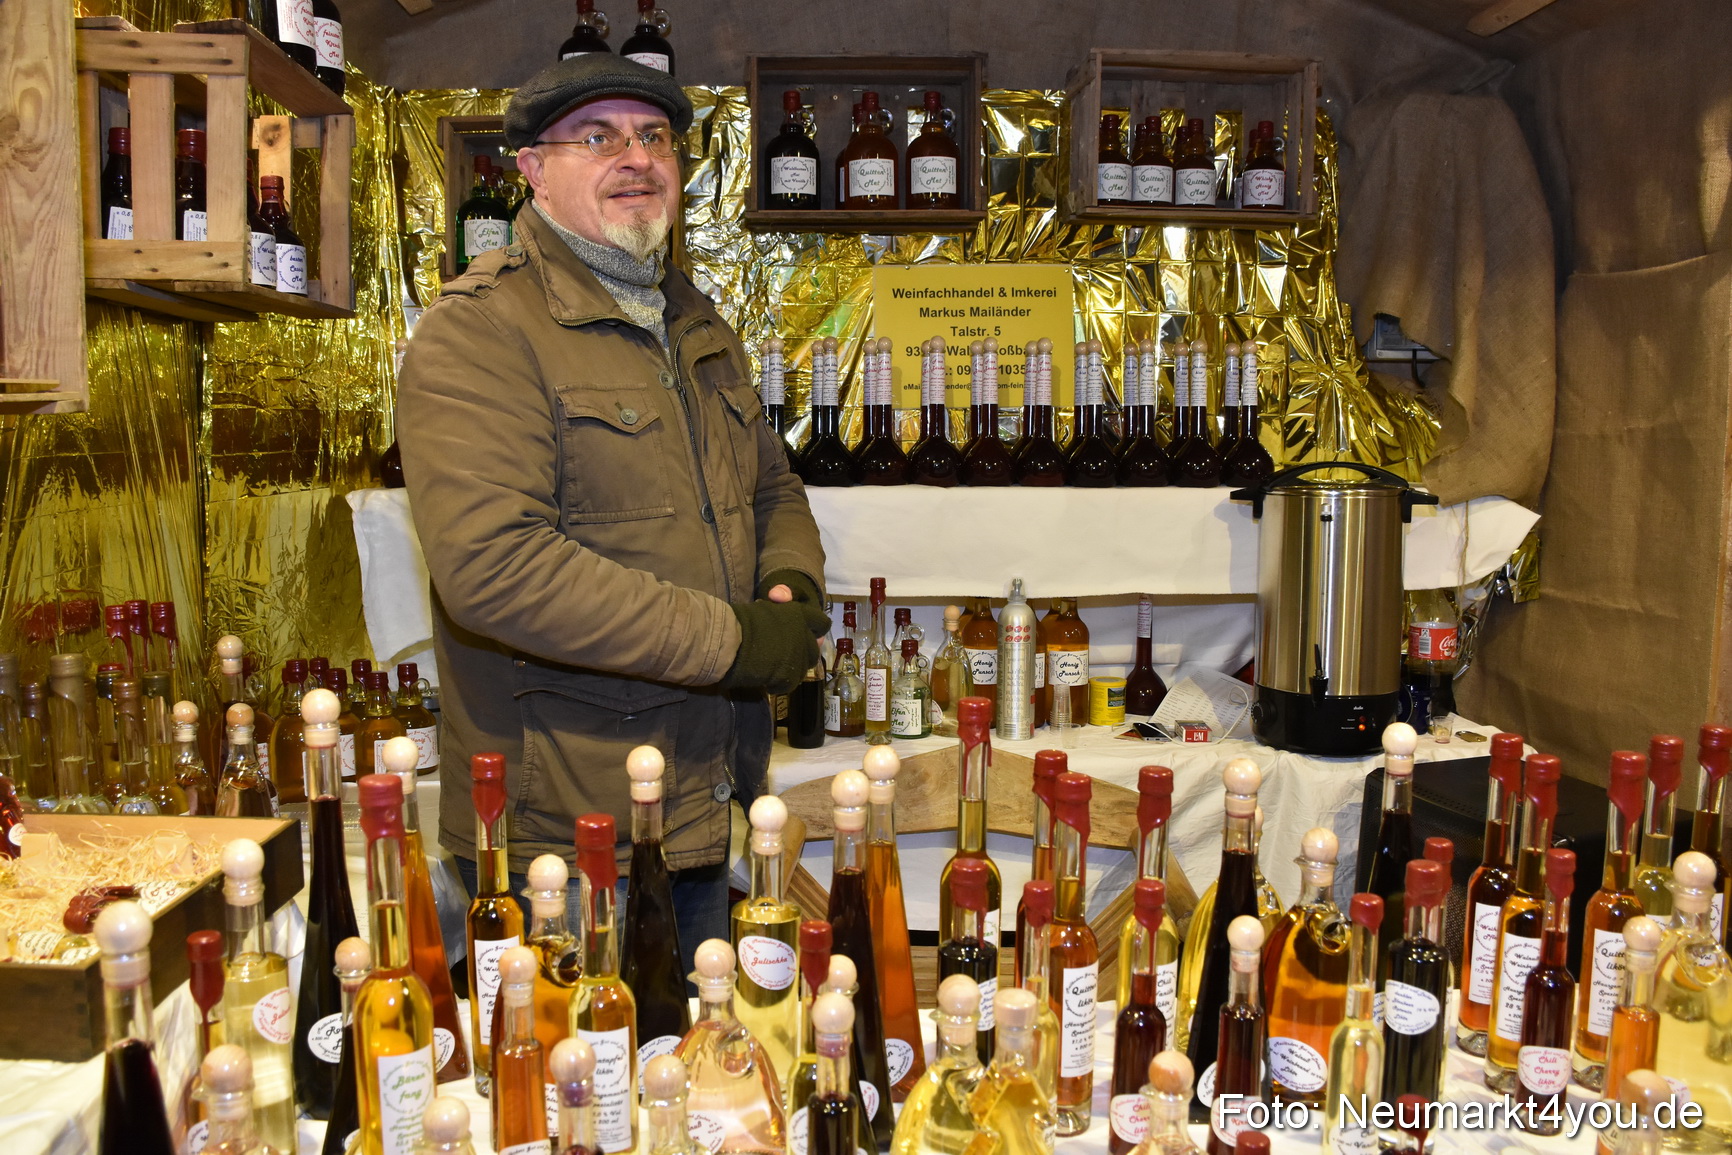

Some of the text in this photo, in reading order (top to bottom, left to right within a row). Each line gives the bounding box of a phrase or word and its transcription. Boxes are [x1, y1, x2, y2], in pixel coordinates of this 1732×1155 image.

[864, 178, 880, 186] Met
[926, 176, 941, 185] Met
[1144, 185, 1160, 193] Met
[1190, 188, 1206, 196] Met
[482, 239, 497, 247] Met
[892, 287, 1056, 298] Weinfachhandel & Imkerei
[920, 306, 1031, 318] Markus Mailänder
[951, 326, 1001, 337] Talstr. 5
[947, 346, 970, 356] Wal
[974, 660, 993, 669] Honig
[751, 956, 788, 967] Julischka
[1538, 1056, 1557, 1064] Chili
[1534, 1066, 1560, 1076] Cherry
[399, 1090, 422, 1104] fang
